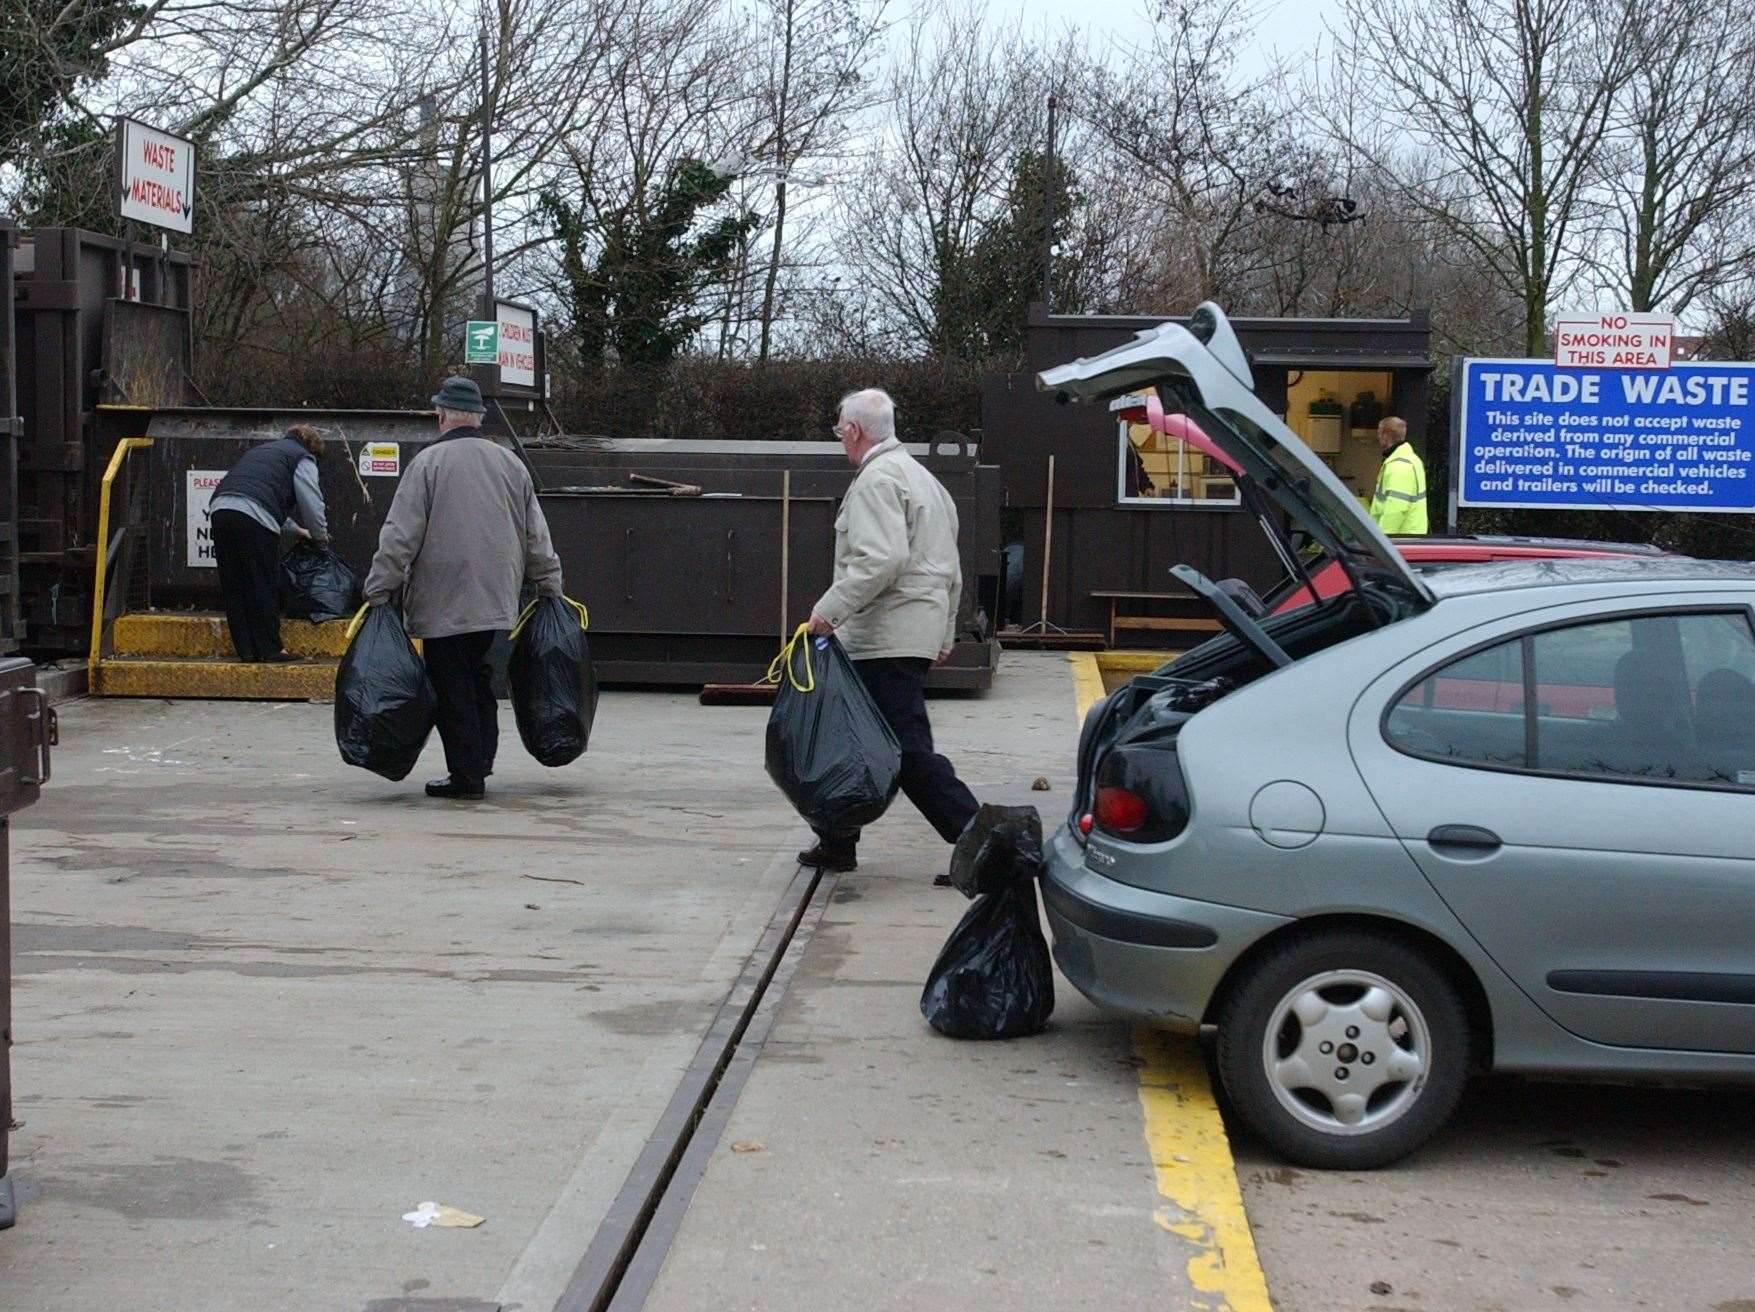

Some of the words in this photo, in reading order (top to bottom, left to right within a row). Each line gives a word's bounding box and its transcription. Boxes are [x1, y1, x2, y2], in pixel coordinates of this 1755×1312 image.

[143, 138, 175, 174] WASTE
[131, 176, 182, 215] MATERIALS
[1601, 316, 1627, 329] NO
[1561, 333, 1642, 348] SMOKING
[1649, 334, 1667, 348] IN
[1568, 350, 1605, 364] THIS
[1612, 352, 1657, 365] AREA
[1480, 372, 1600, 404] TRADE
[1621, 375, 1749, 406] WASTE
[1486, 411, 1520, 425] This
[1524, 411, 1553, 425] site
[1558, 412, 1598, 427] does
[1602, 415, 1630, 427] not
[1634, 416, 1688, 431] accept
[1692, 416, 1742, 429] waste
[1491, 428, 1555, 442] derived
[1560, 428, 1600, 442] from
[1603, 433, 1634, 447] any
[1639, 432, 1736, 446] commercial
[1474, 444, 1560, 459] operation.
[1565, 444, 1595, 458] The
[1600, 445, 1650, 462] origin
[1655, 446, 1673, 460] of
[1676, 447, 1698, 460] all
[1702, 449, 1752, 461] waste
[1474, 460, 1553, 474] delivered
[1558, 462, 1574, 475] in
[1579, 463, 1675, 477] commercial
[1679, 464, 1747, 478] vehicles
[1480, 477, 1513, 491] and
[1518, 478, 1578, 492] trailers
[1582, 478, 1611, 493] will
[1614, 479, 1635, 493] be
[1640, 480, 1714, 494] checked.
